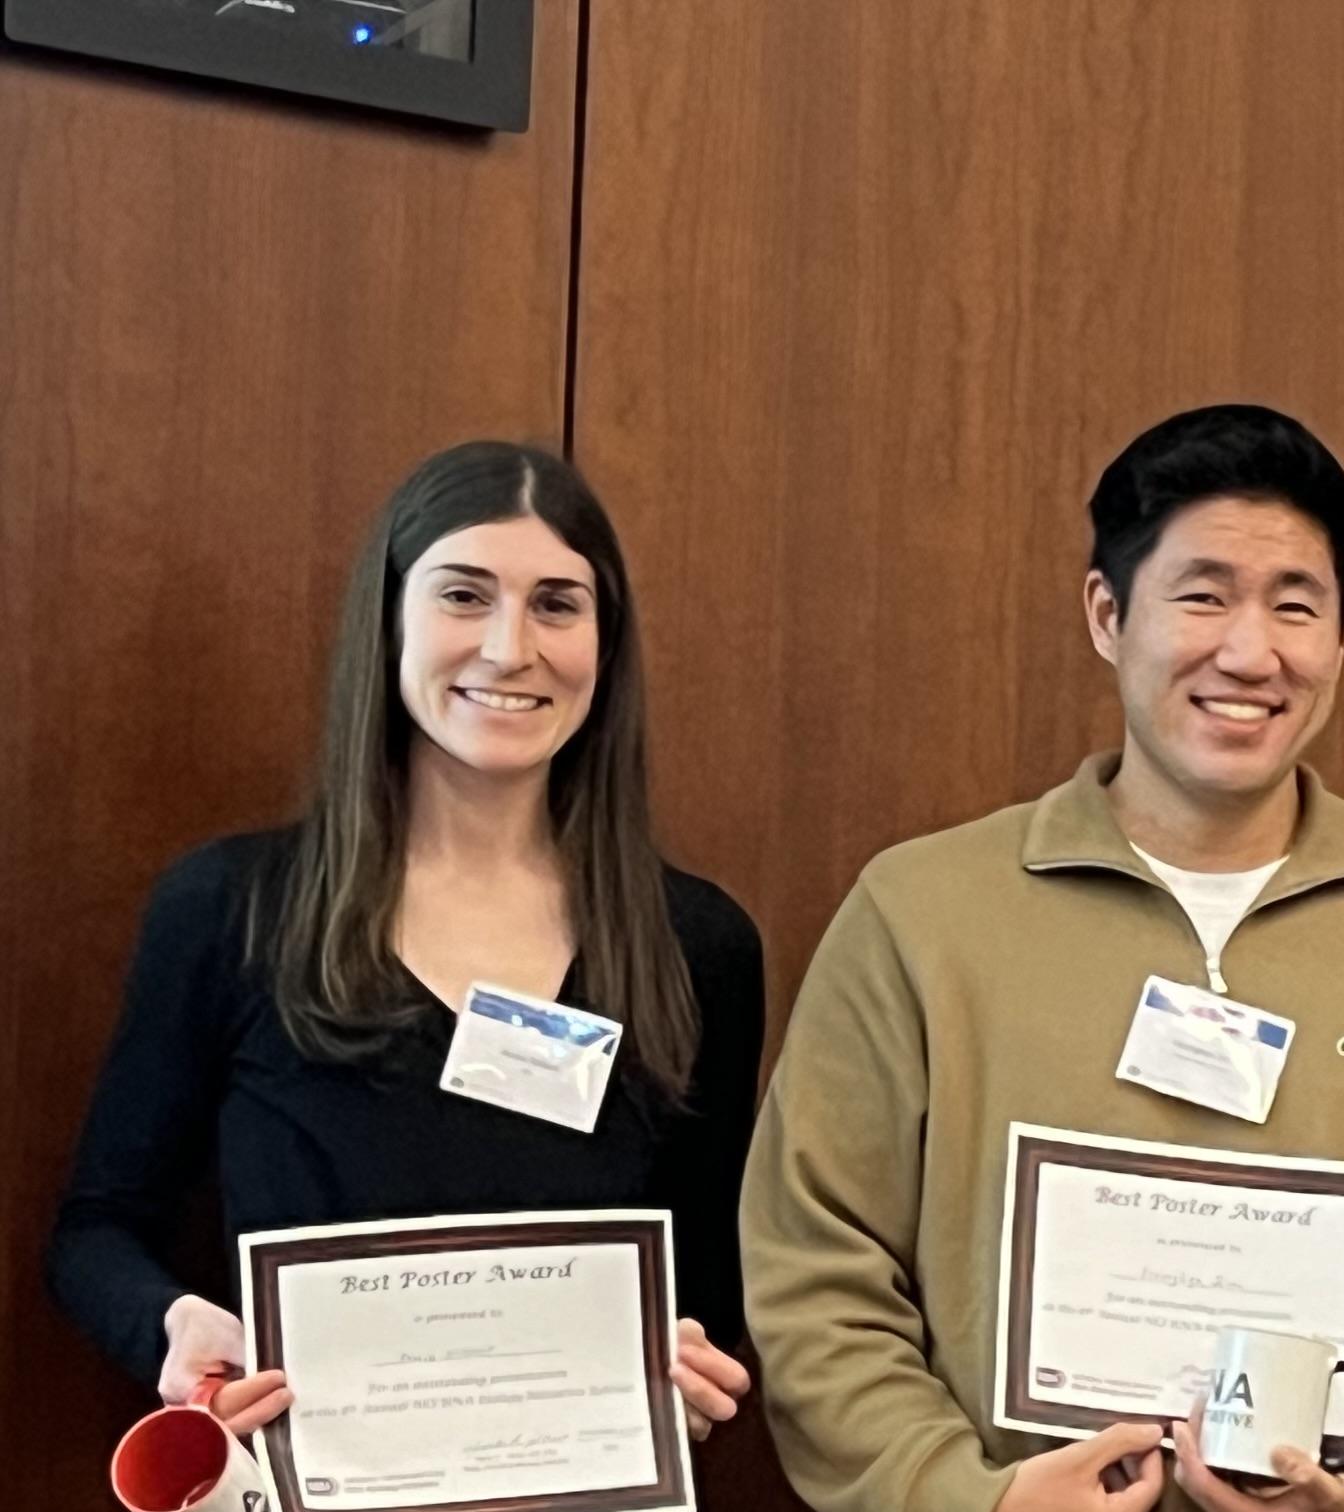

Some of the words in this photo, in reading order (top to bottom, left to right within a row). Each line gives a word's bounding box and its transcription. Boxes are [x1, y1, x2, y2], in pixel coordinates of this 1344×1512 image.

[1094, 1186, 1142, 1208] Best
[1149, 1193, 1223, 1218] Poster
[1228, 1203, 1320, 1227] Award
[339, 1274, 391, 1295] Best
[399, 1268, 478, 1290] Poster
[484, 1256, 579, 1284] Award
